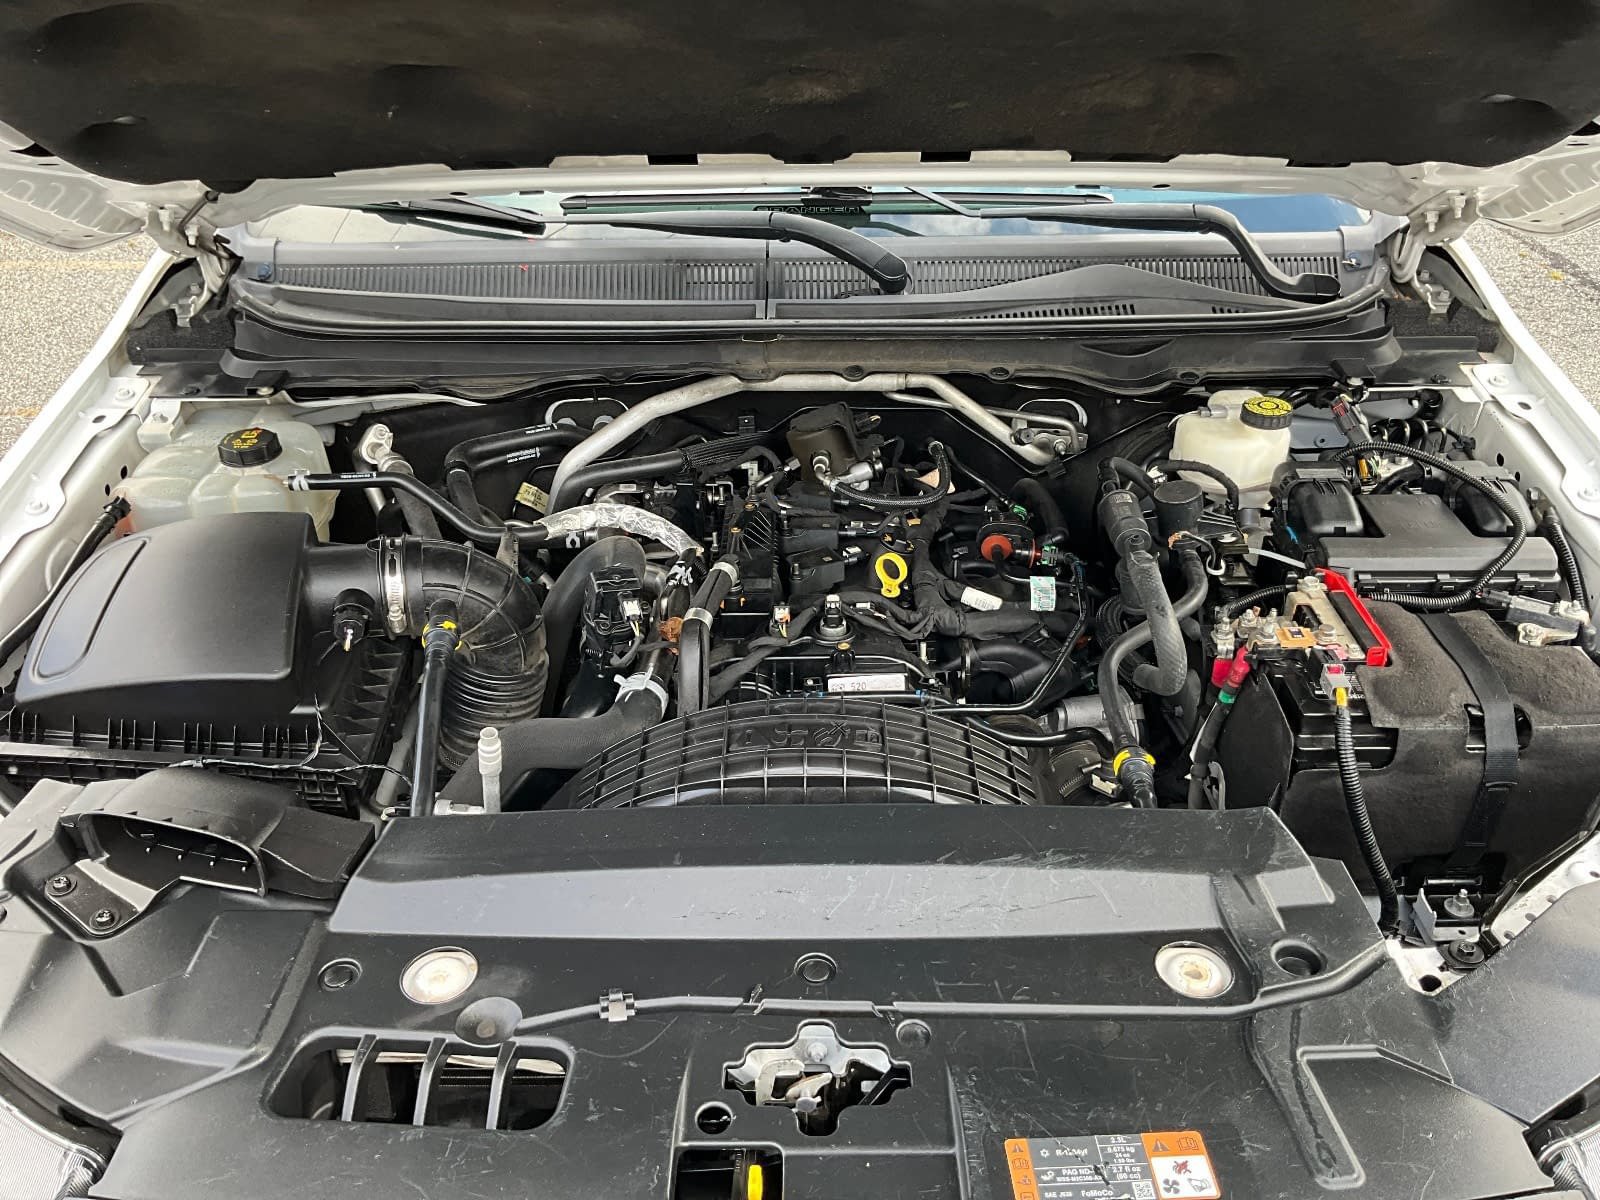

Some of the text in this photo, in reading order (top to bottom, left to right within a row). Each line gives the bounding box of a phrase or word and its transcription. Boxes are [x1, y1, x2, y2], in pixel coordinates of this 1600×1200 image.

[769, 206, 860, 214] RANGER
[1110, 1136, 1127, 1144] 2.3L
[1062, 1168, 1078, 1176] PAG
[1081, 1189, 1114, 1198] FoMoCo
